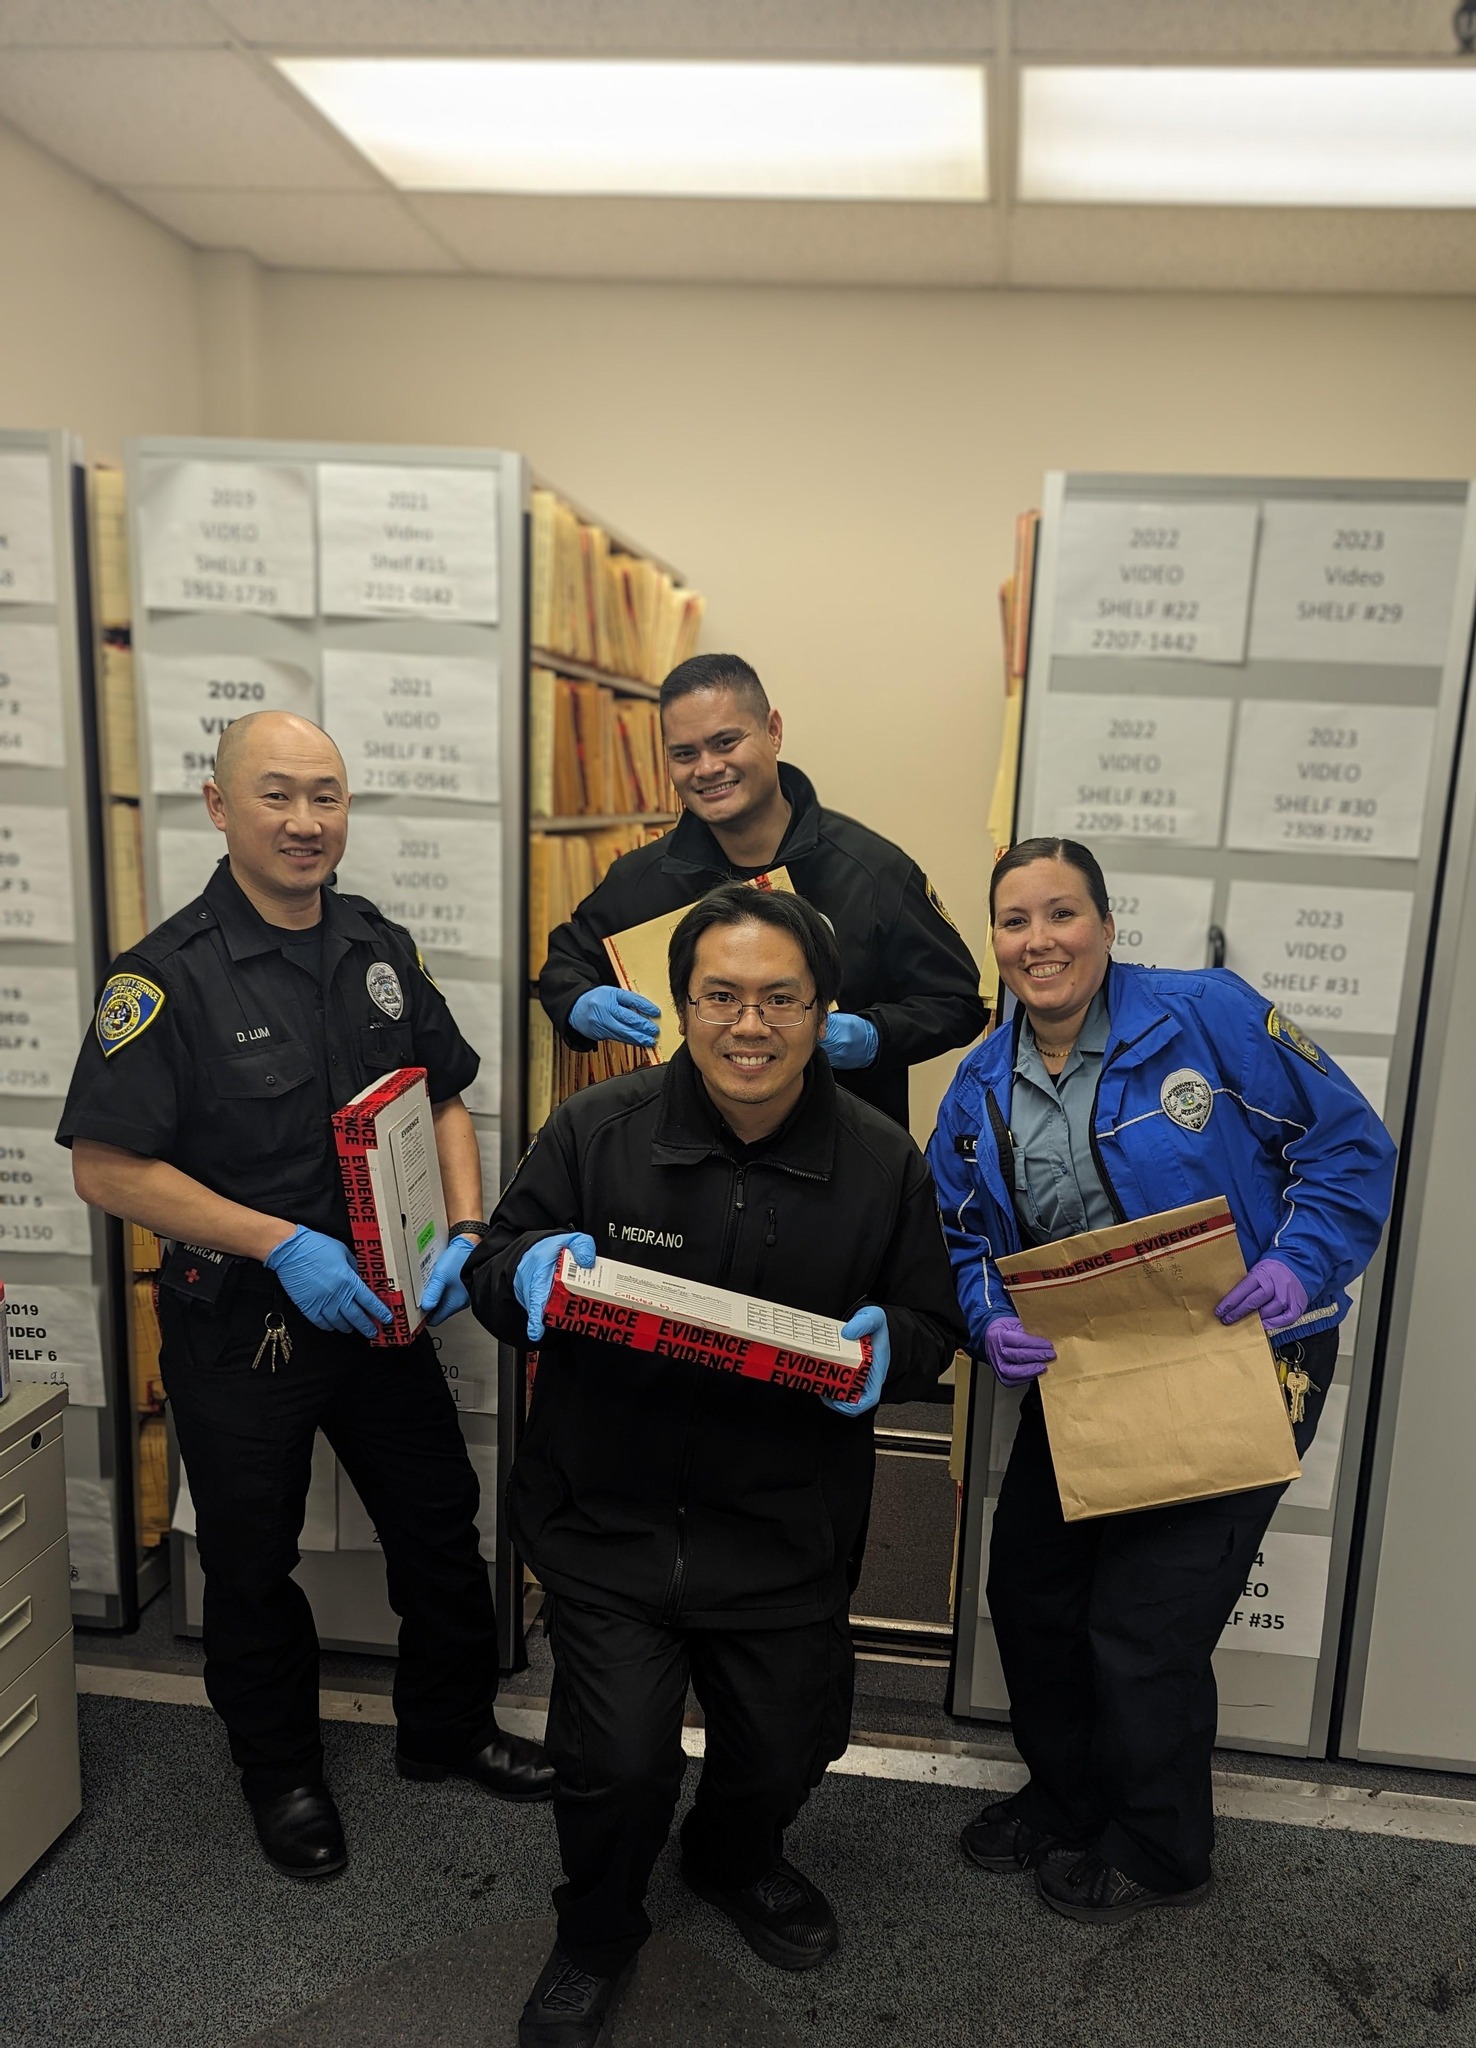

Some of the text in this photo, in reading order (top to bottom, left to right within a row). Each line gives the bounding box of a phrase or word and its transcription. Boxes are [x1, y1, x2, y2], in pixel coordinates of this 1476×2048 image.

[199, 521, 259, 543] VIDEO
[1128, 528, 1180, 549] 2022
[1331, 529, 1385, 551] 2023
[1119, 563, 1184, 586] VIDEO
[1323, 565, 1385, 587] Video
[1097, 597, 1156, 619] SHELF
[1295, 600, 1404, 625] SHELF #29
[208, 681, 264, 702] 2020
[388, 677, 431, 698] 2021
[382, 710, 441, 731] VIDEO
[1108, 719, 1158, 739] 2022
[1306, 726, 1359, 749] 2023
[362, 741, 417, 761] SHELF
[1098, 752, 1162, 774] VIDEO
[1297, 762, 1362, 784] VIDEO
[1076, 785, 1135, 806] SHELF
[1272, 793, 1335, 815] SHELF
[391, 871, 449, 891] VIDEO
[1295, 908, 1344, 929] 2023
[1284, 941, 1348, 962] VIDEO
[112, 985, 143, 1000] OFFICER
[1261, 972, 1360, 995] SHELF #31
[236, 1026, 271, 1043] D. LUM
[401, 1115, 420, 1138] EVIDENCE
[0, 1171, 33, 1184] DEO
[339, 1155, 360, 1224] EVIDENCE
[352, 1155, 376, 1224] EVIDENCE
[608, 1222, 684, 1249] R. MEDRANO
[1135, 1221, 1210, 1255] EVIDENCE
[1041, 1252, 1115, 1282] EVIDENCE
[614, 1290, 654, 1306] Collected
[6, 1304, 39, 1315] 2019
[8, 1327, 47, 1339] IDEO
[9, 1349, 57, 1361] HELF 6
[544, 1312, 863, 1404] EVIDENCE EVIDENCE EVIDENCE
[658, 1318, 751, 1357] EVIDENCE
[774, 1349, 856, 1383] EVIDENC
[440, 1364, 459, 1379] 20
[1249, 1612, 1285, 1630] #35
